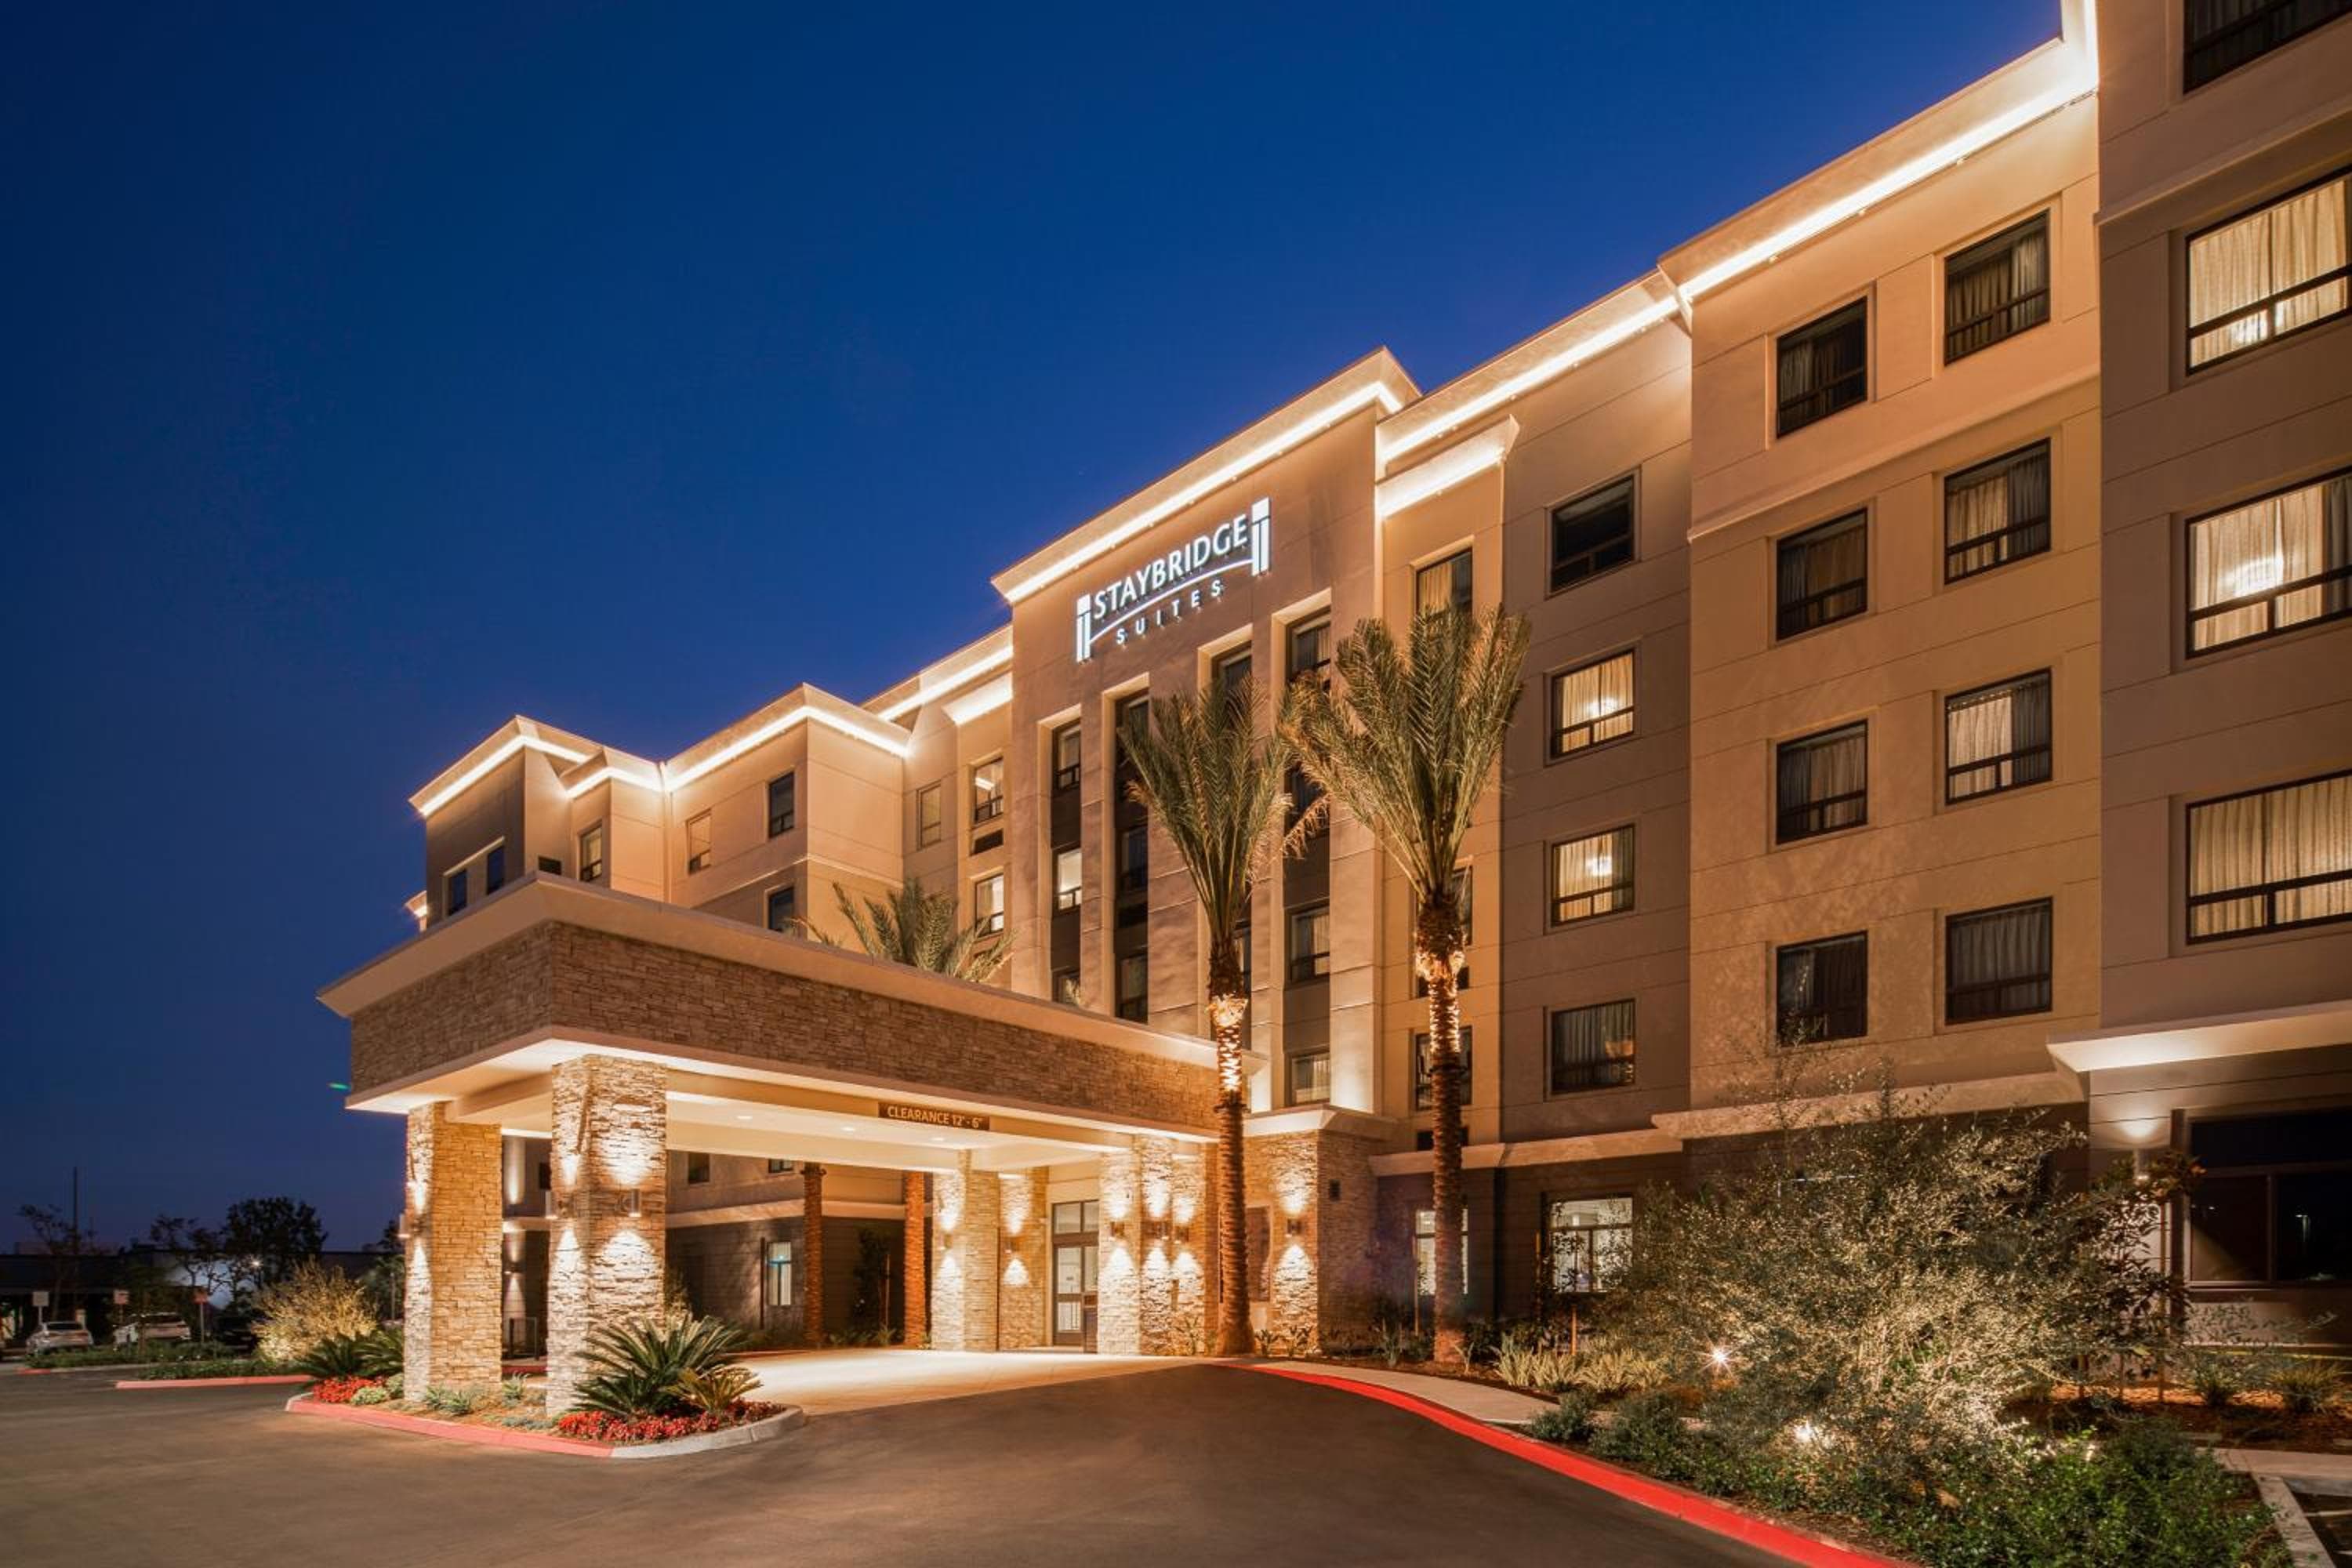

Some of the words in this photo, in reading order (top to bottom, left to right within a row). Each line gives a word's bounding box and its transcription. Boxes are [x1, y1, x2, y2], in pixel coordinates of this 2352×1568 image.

[1094, 514, 1247, 619] STAYBRIDGE
[1116, 579, 1221, 644] SUITES
[887, 1105, 949, 1124] CLEARANCE
